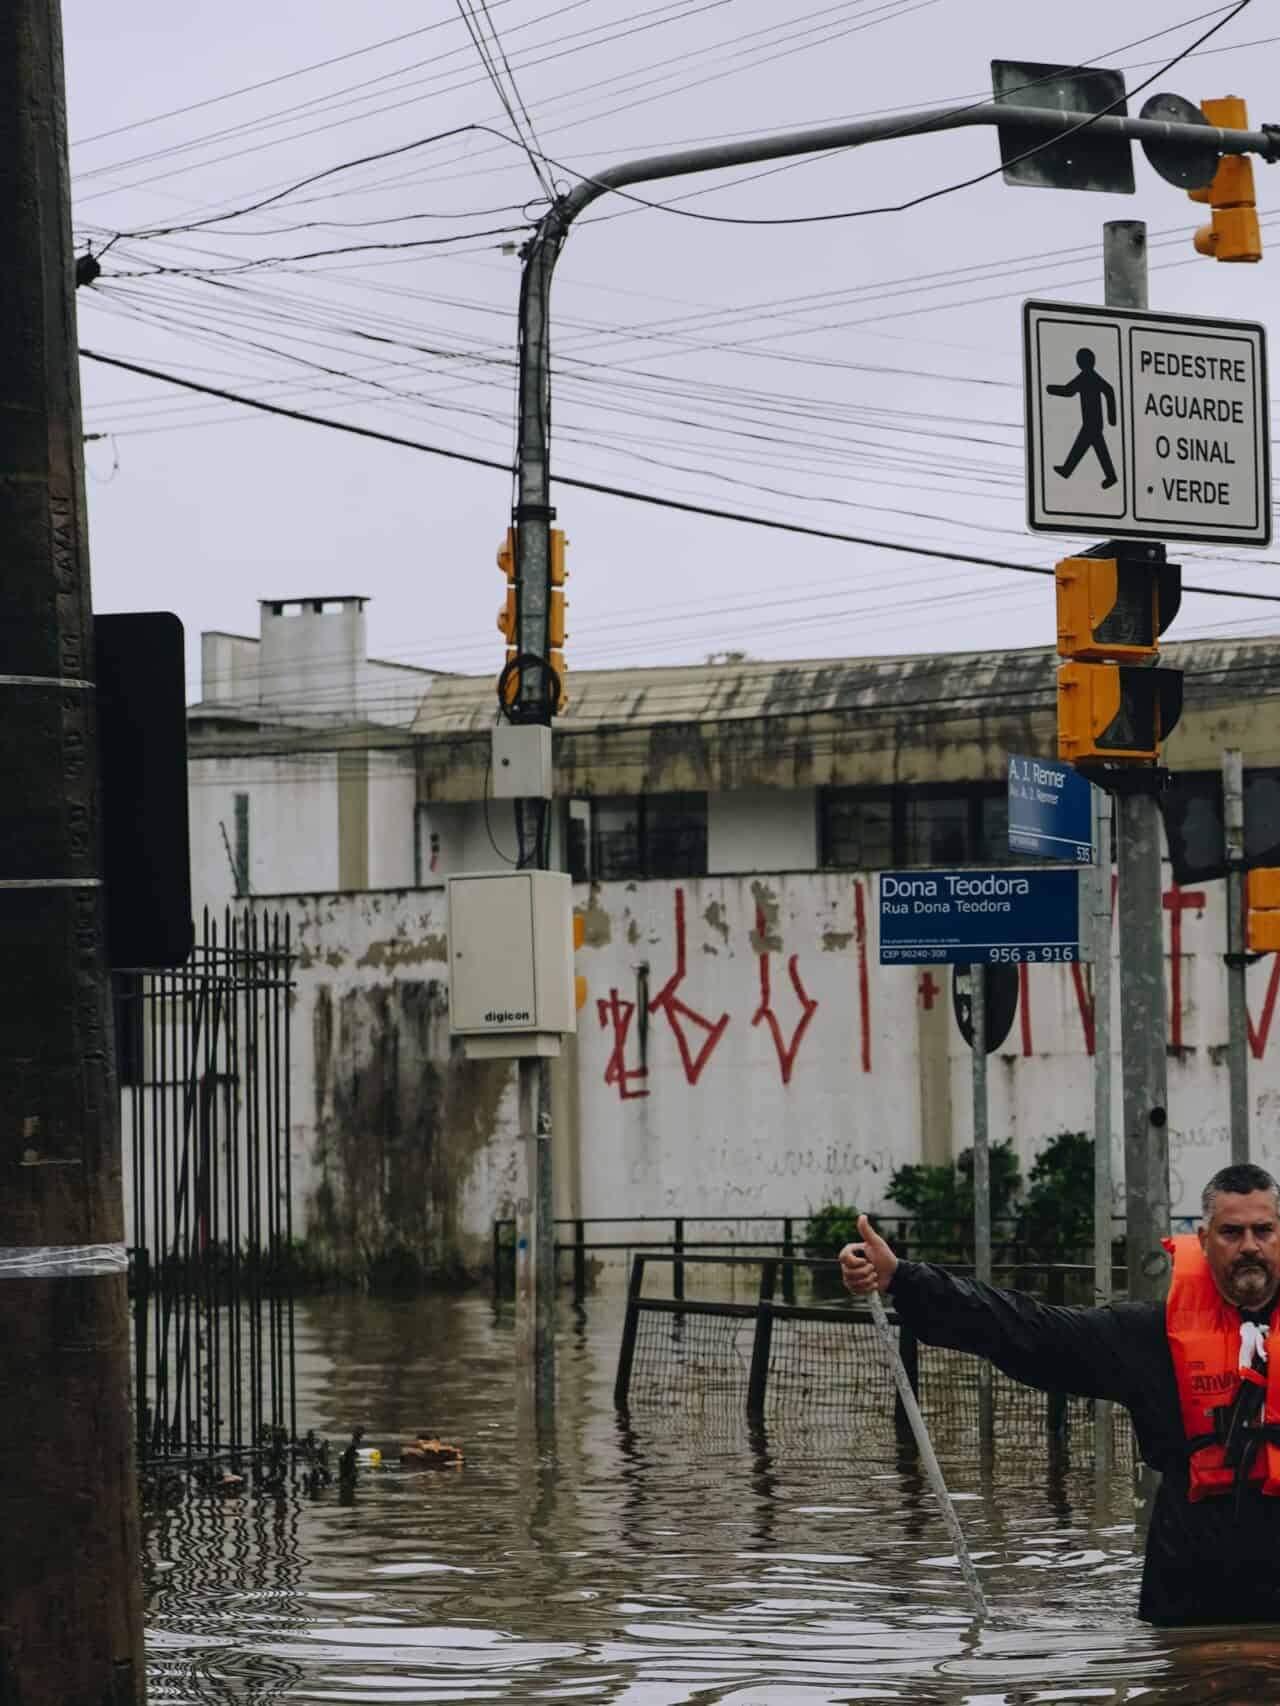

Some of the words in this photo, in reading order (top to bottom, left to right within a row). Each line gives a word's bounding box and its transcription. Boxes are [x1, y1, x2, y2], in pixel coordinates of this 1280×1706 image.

[1140, 350, 1246, 382] PEDESTRE
[1144, 393, 1244, 424] AGUARDE
[1155, 436, 1170, 459] O
[1176, 437, 1235, 464] SINAL
[1162, 478, 1230, 505] VERDE
[882, 878, 937, 897] Dona
[944, 875, 1029, 896] Teodora
[882, 902, 909, 914] Rua
[914, 901, 950, 913] Dona
[955, 899, 1011, 913] Teodora
[989, 948, 1020, 962] 956
[1026, 951, 1036, 962] a
[1041, 947, 1073, 961] 916
[484, 1011, 529, 1023] digicon
